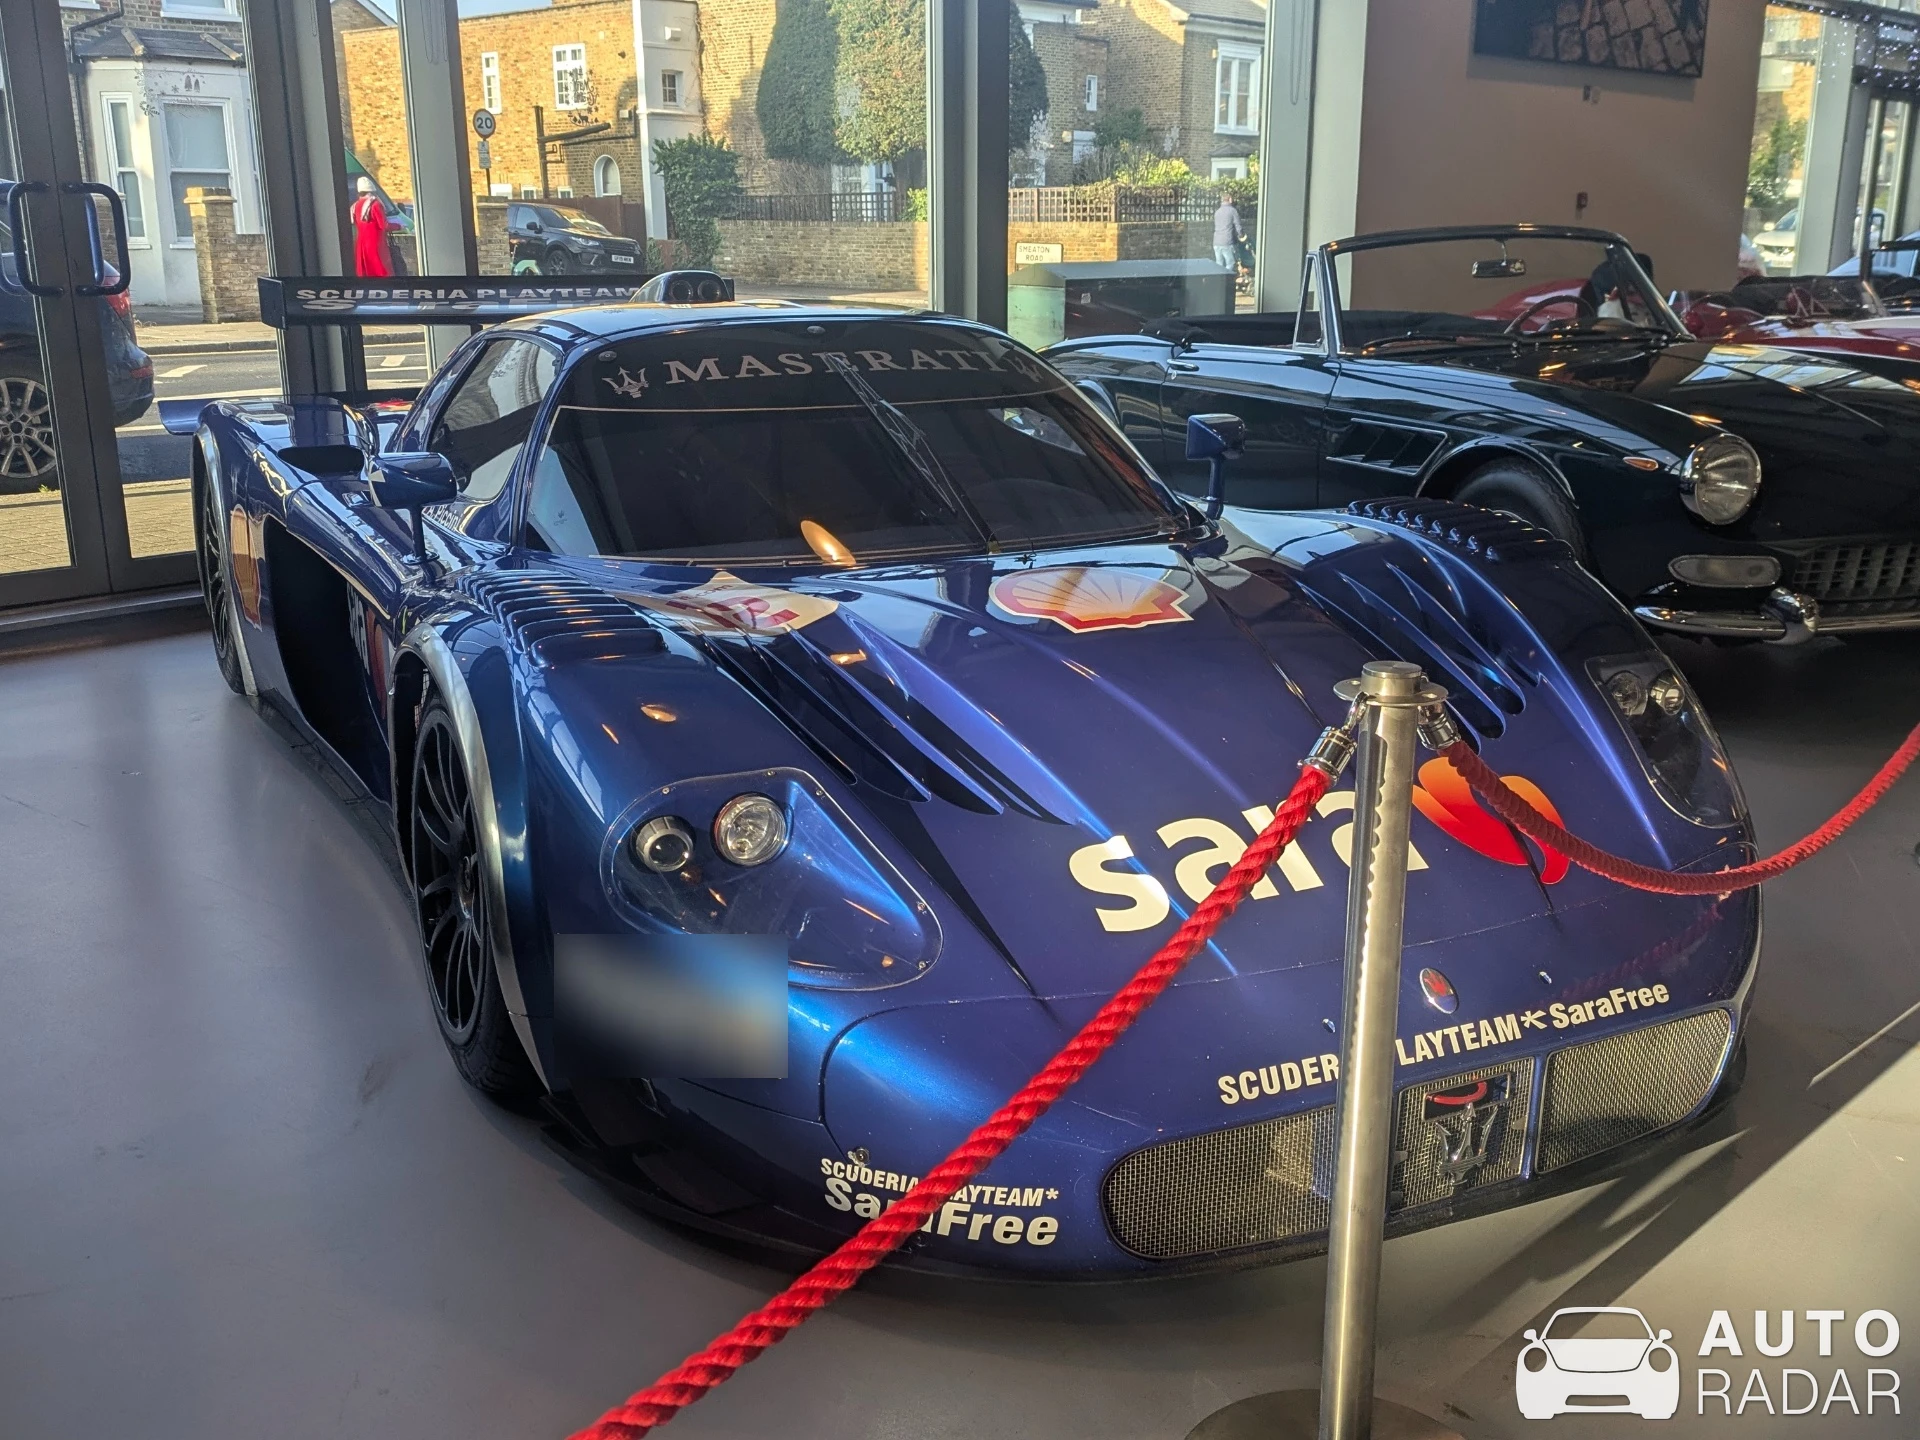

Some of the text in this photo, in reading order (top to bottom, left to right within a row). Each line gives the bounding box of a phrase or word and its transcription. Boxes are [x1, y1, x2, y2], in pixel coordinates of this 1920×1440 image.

[476, 116, 493, 130] 20
[1018, 245, 1050, 253] SMEATON
[296, 287, 640, 299] SCUDERIA PLAYTEAM
[663, 348, 1007, 386] MASERATI
[1217, 983, 1670, 1105] SCUDER LAYTEAM SaraFree
[949, 1184, 1060, 1207] AYTEAM
[824, 1177, 1060, 1246] SaFree
